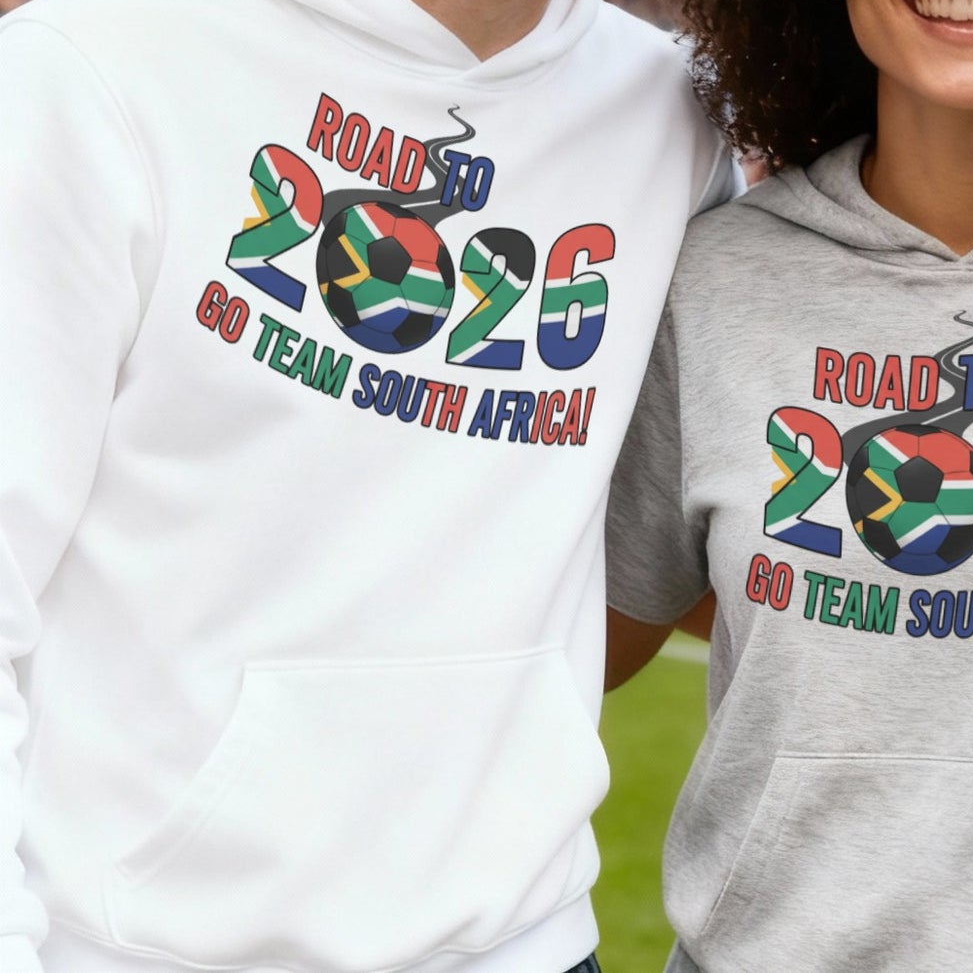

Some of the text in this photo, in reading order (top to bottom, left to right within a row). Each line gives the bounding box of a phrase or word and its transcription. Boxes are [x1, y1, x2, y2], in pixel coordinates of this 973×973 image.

[307, 92, 495, 212] ROAD TO
[196, 280, 597, 446] GO TEAM SOUTH AFRICA!
[813, 346, 940, 411] ROAD
[745, 553, 794, 611] GO
[803, 569, 900, 635] TEAM
